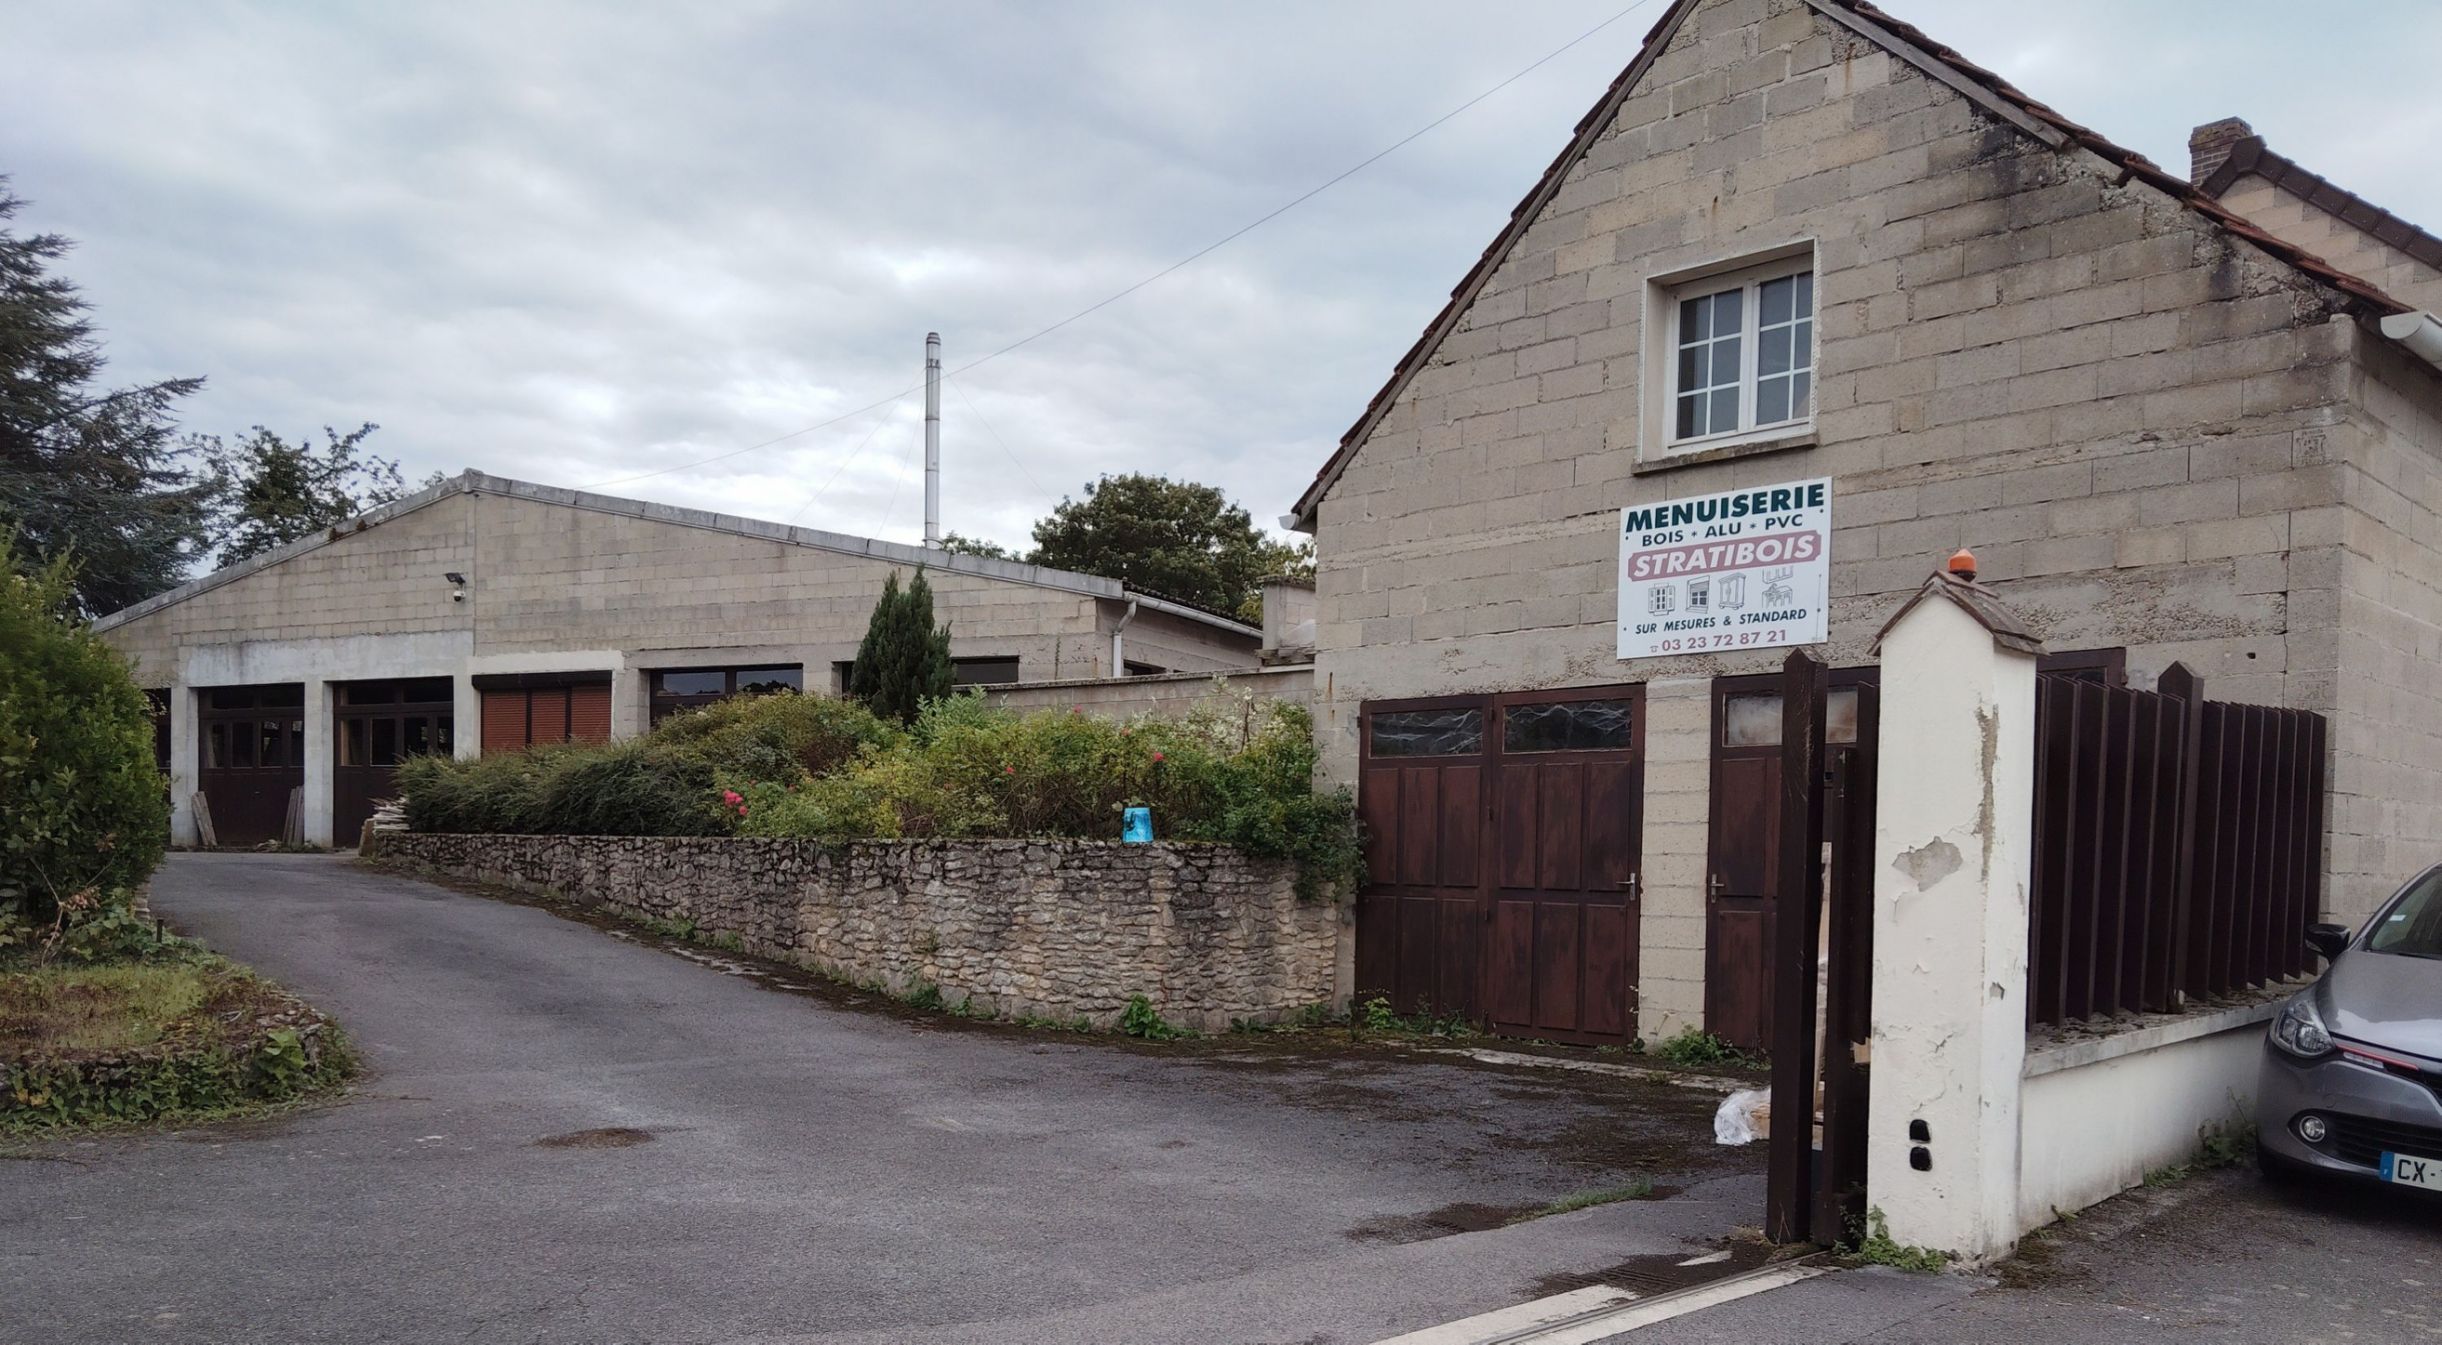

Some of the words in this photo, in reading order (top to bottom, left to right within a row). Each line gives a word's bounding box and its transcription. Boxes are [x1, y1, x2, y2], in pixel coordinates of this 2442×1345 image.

[1625, 483, 1825, 533] MENUISERIE
[1642, 530, 1684, 547] BOIS
[1705, 522, 1742, 538] ALU
[1765, 514, 1803, 530] PVC
[1633, 535, 1815, 577] STRATIBOIS
[1635, 623, 1657, 635] SUR
[1663, 617, 1716, 632] MESURES
[1723, 615, 1732, 626] &
[1739, 608, 1807, 625] STANDARD
[1661, 639, 1681, 651] 03
[1687, 636, 1707, 649] 23
[1713, 634, 1733, 647] 72
[1739, 632, 1761, 645] 87
[1767, 629, 1787, 643] 21
